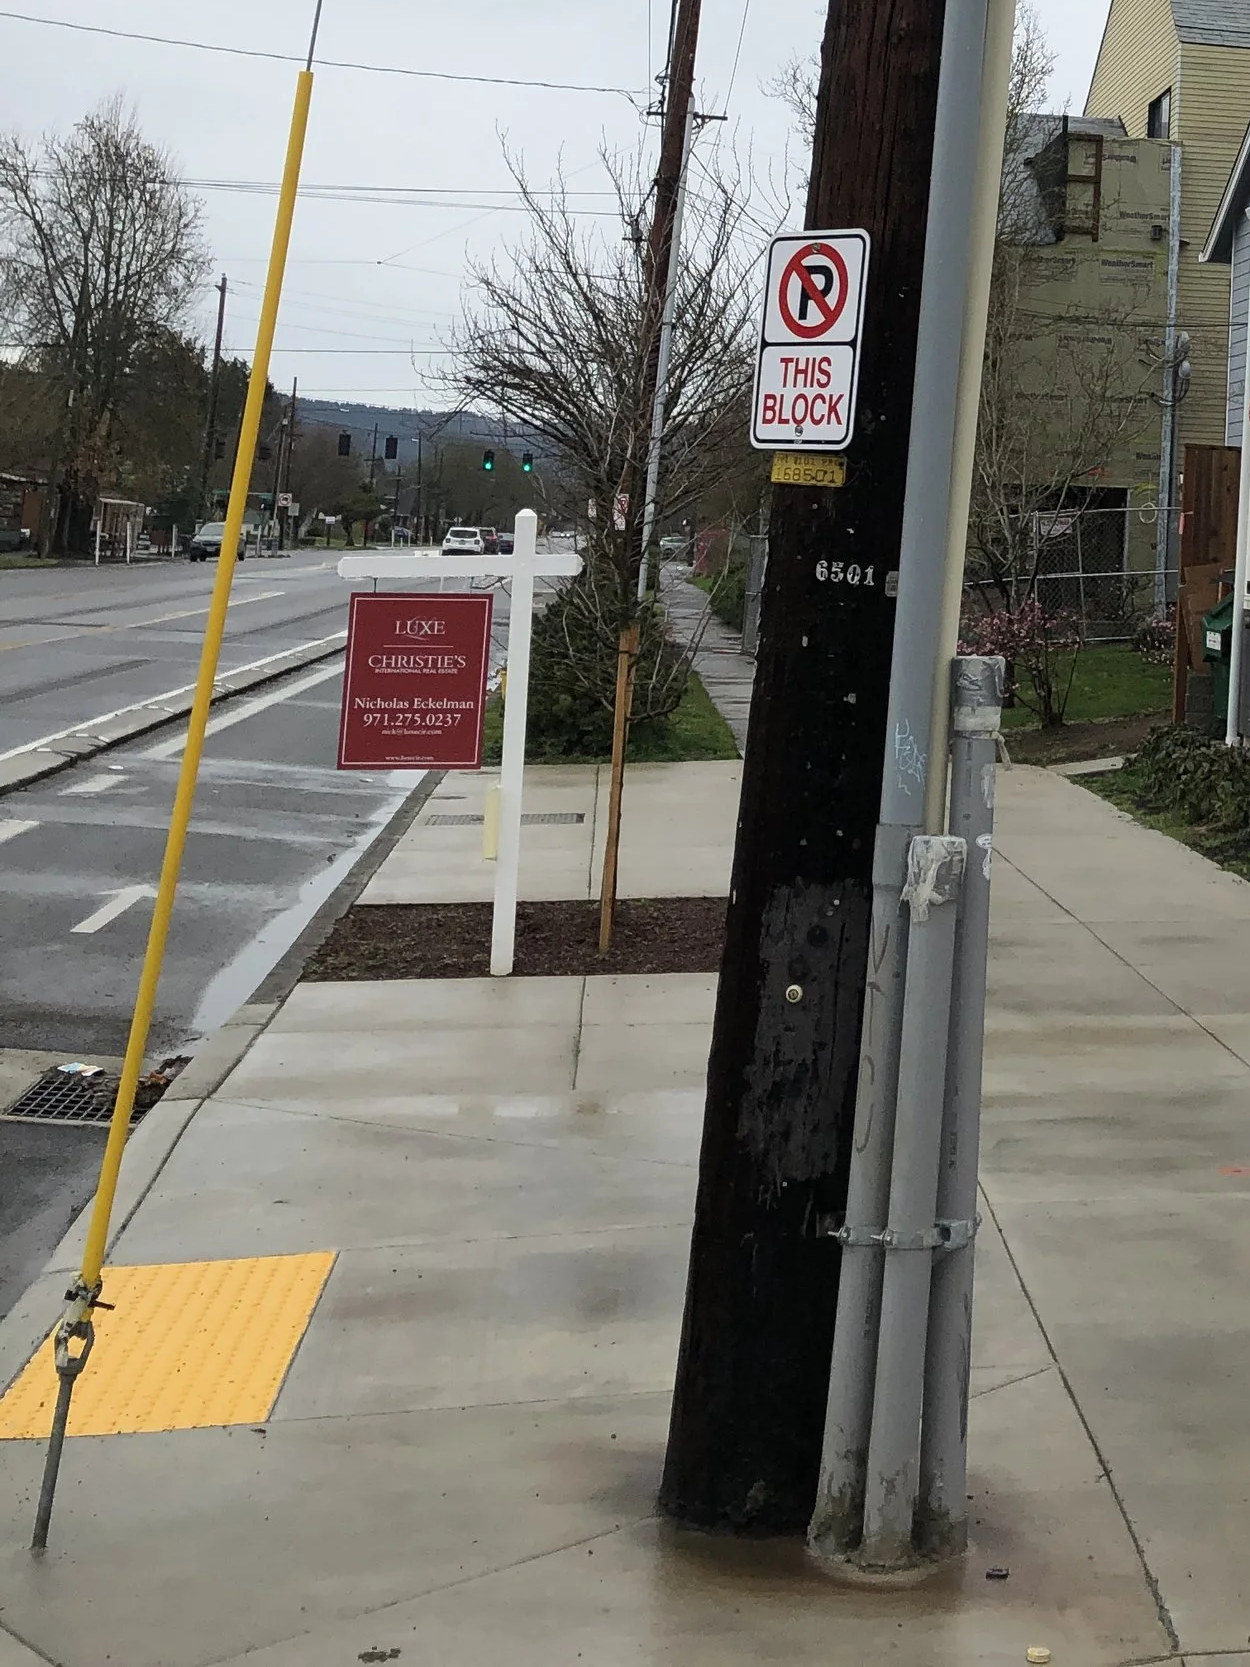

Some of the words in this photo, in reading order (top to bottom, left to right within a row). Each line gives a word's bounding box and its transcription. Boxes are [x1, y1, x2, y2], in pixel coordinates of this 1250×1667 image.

[779, 356, 832, 389] THIS
[762, 393, 845, 426] BLOCK
[774, 466, 836, 484] 168501
[815, 560, 875, 585] 6501
[395, 620, 445, 635] LUXE
[368, 655, 467, 668] CHRISTIE'S
[354, 697, 409, 709] Nicholas
[412, 697, 474, 709] Eckelman
[363, 713, 461, 727] 971.275.0237
